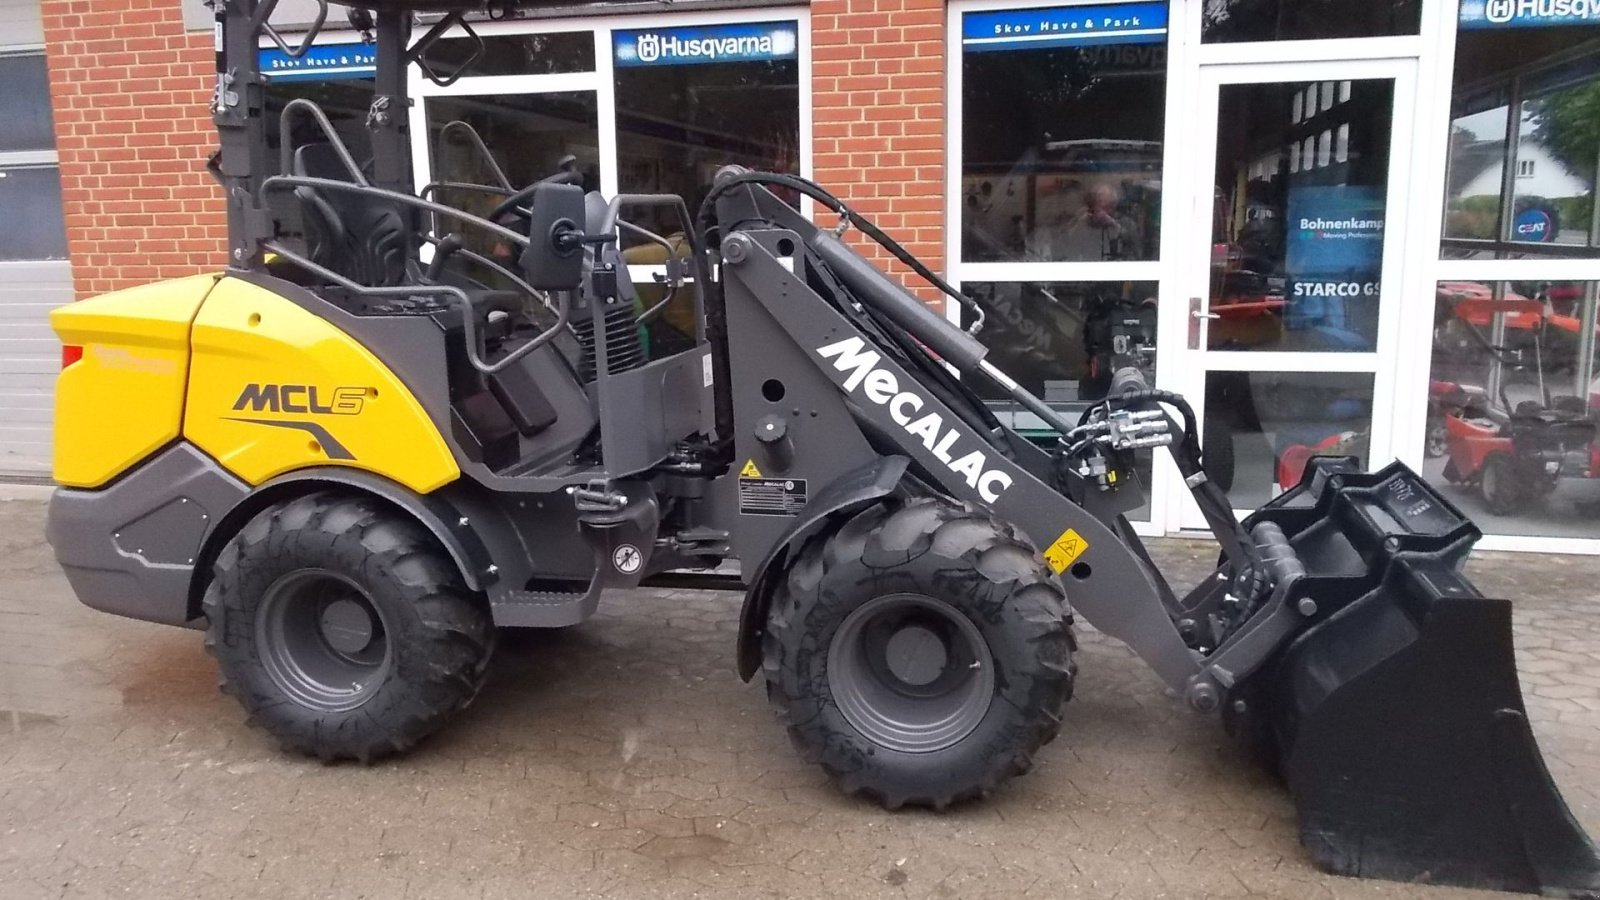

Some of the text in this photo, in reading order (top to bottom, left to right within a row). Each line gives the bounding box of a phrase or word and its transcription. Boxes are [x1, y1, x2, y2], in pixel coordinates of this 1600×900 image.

[994, 17, 1141, 34] Skov Have & Park
[661, 35, 772, 60] Husqvarna
[272, 59, 300, 68] Skov
[306, 57, 337, 66] Have
[341, 56, 348, 65] &
[1300, 217, 1384, 231] Bohnenkamp
[1518, 222, 1546, 233] CEAT
[1293, 282, 1360, 297] STARCO
[232, 383, 369, 416] MCL6
